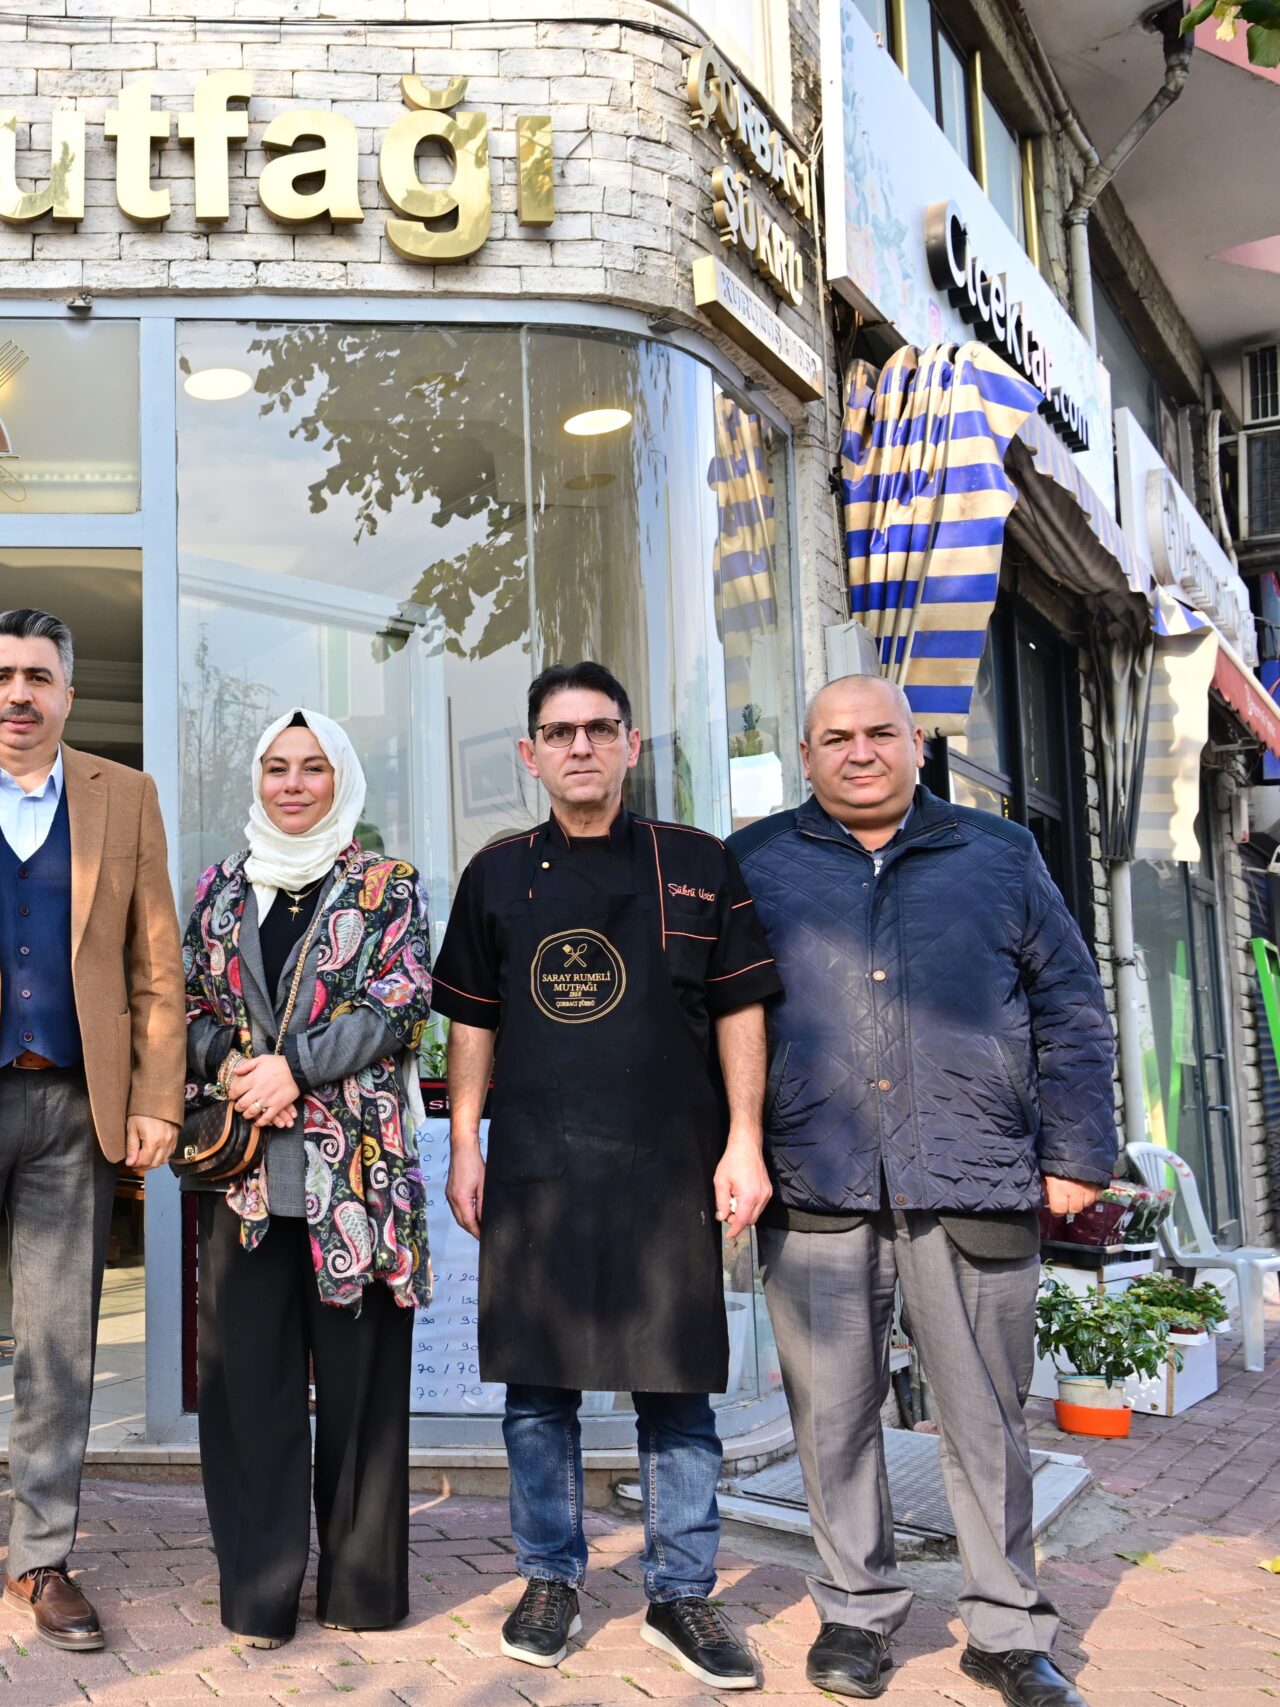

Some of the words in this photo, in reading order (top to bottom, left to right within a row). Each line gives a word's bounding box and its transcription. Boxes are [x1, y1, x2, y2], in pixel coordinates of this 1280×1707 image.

[667, 883, 697, 897] Şükrü
[698, 888, 716, 902] Usta
[542, 973, 572, 982] SARAY
[573, 970, 611, 981] RUMELİ
[553, 981, 598, 992] MUTFAĞI
